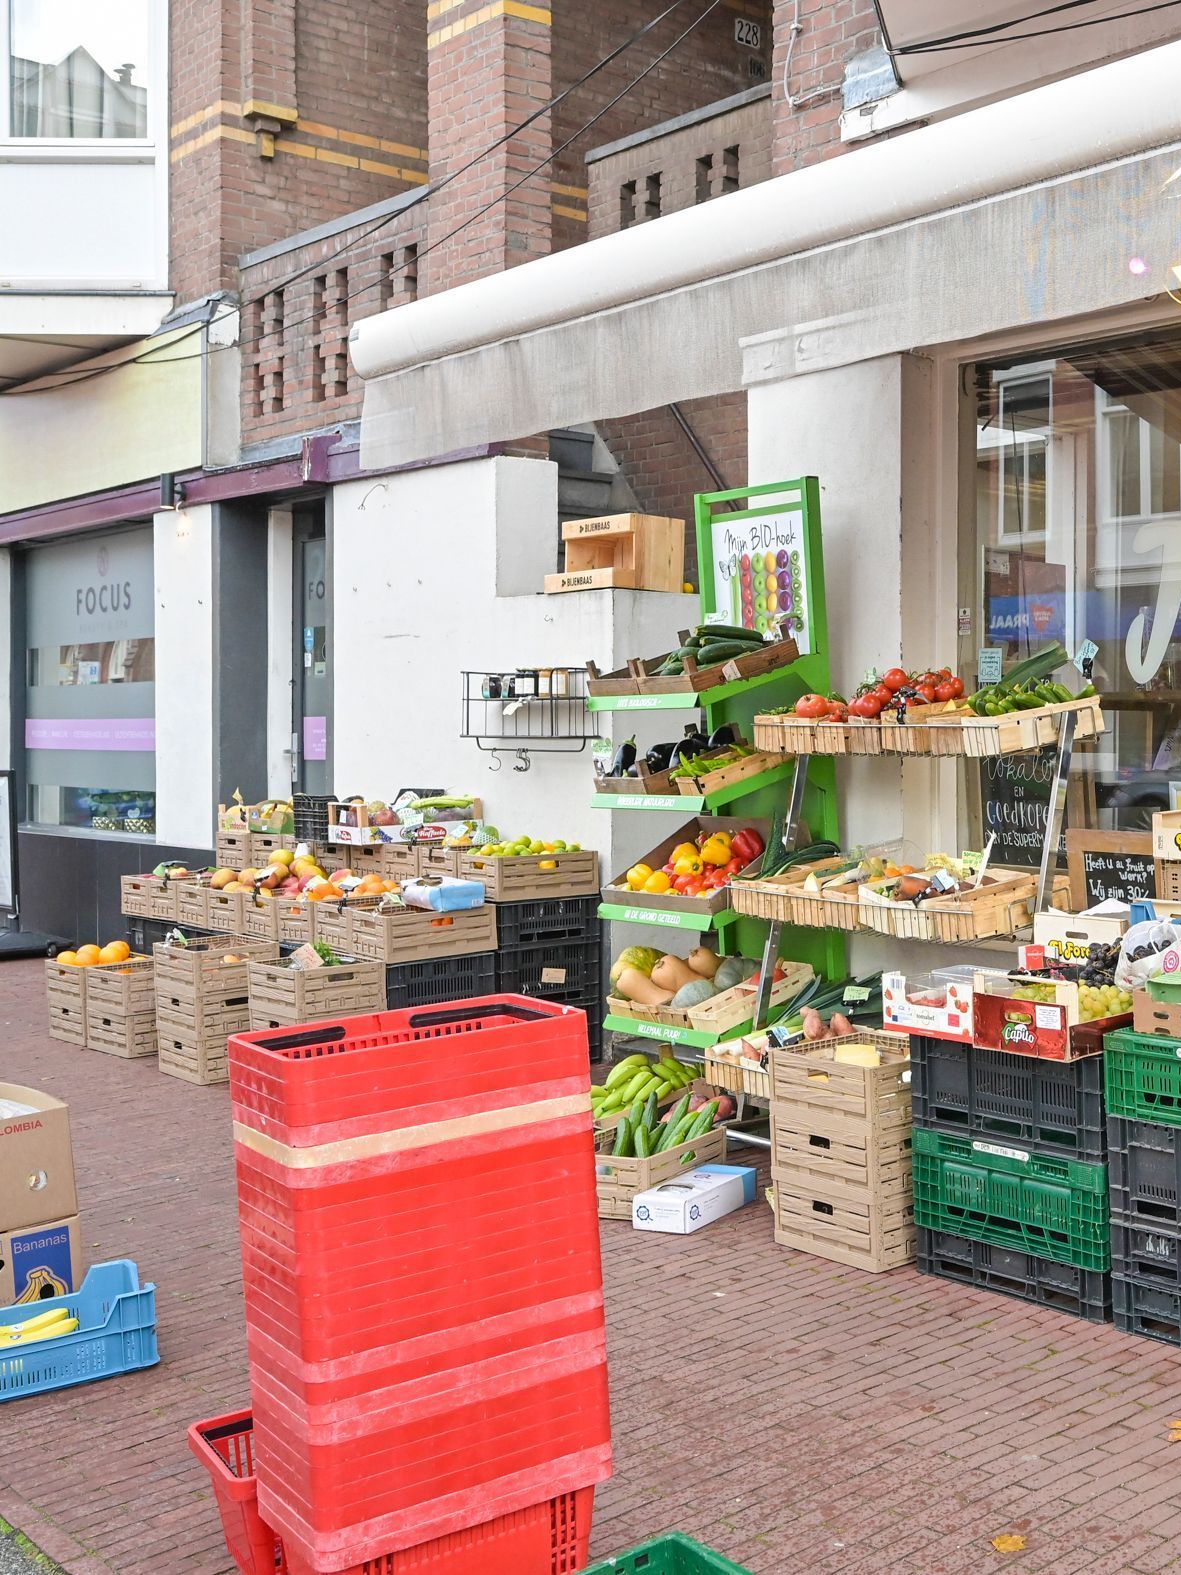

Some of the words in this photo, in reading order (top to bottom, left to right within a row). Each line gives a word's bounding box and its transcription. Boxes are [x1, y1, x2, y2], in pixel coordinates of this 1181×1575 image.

[737, 20, 759, 47] 228
[584, 521, 611, 534] BIJENBAAS
[724, 528, 748, 554] Mijn
[749, 520, 797, 551] BIO-hoek
[566, 576, 593, 588] BIJENBAAS
[76, 581, 131, 616] FOCUS
[983, 753, 1053, 783] lokale
[1013, 785, 1025, 798] EN
[1085, 853, 1106, 871] Heeft
[1146, 864, 1155, 876] op
[1089, 879, 1106, 901] Wij
[1107, 886, 1125, 900] zijn
[631, 910, 639, 919] DE
[638, 911, 657, 922] GROND
[657, 912, 681, 925] GETEELD
[1004, 1028, 1035, 1045] Capito
[13, 1233, 68, 1254] Bananas
